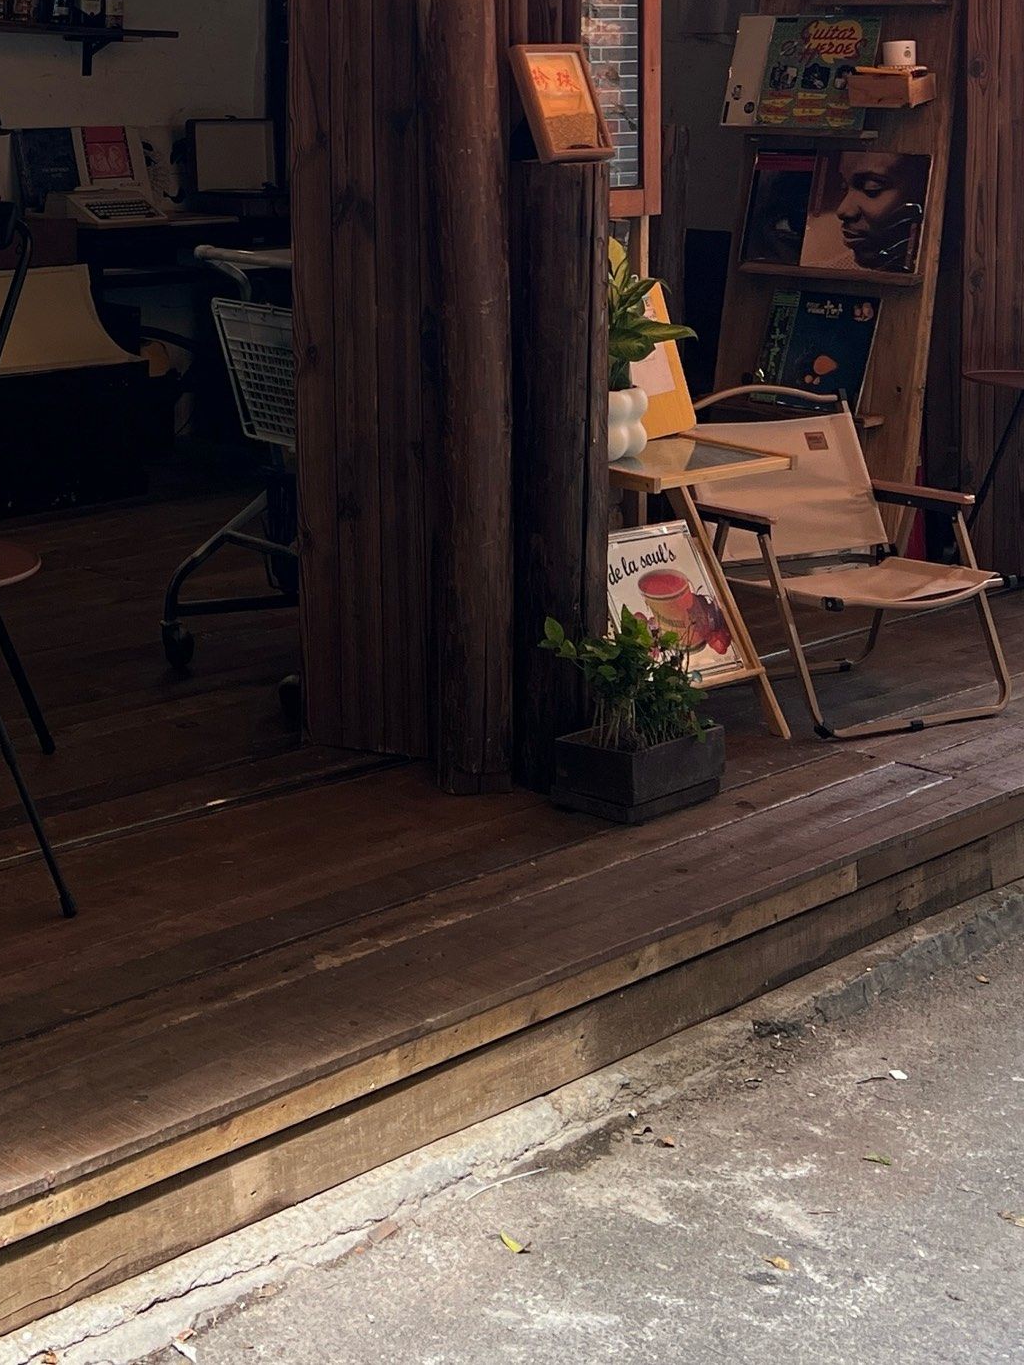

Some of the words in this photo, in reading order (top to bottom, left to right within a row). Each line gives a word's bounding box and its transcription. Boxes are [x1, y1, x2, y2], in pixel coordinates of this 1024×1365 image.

[608, 564, 624, 586] de
[622, 556, 639, 576] la
[640, 542, 677, 569] soul's
